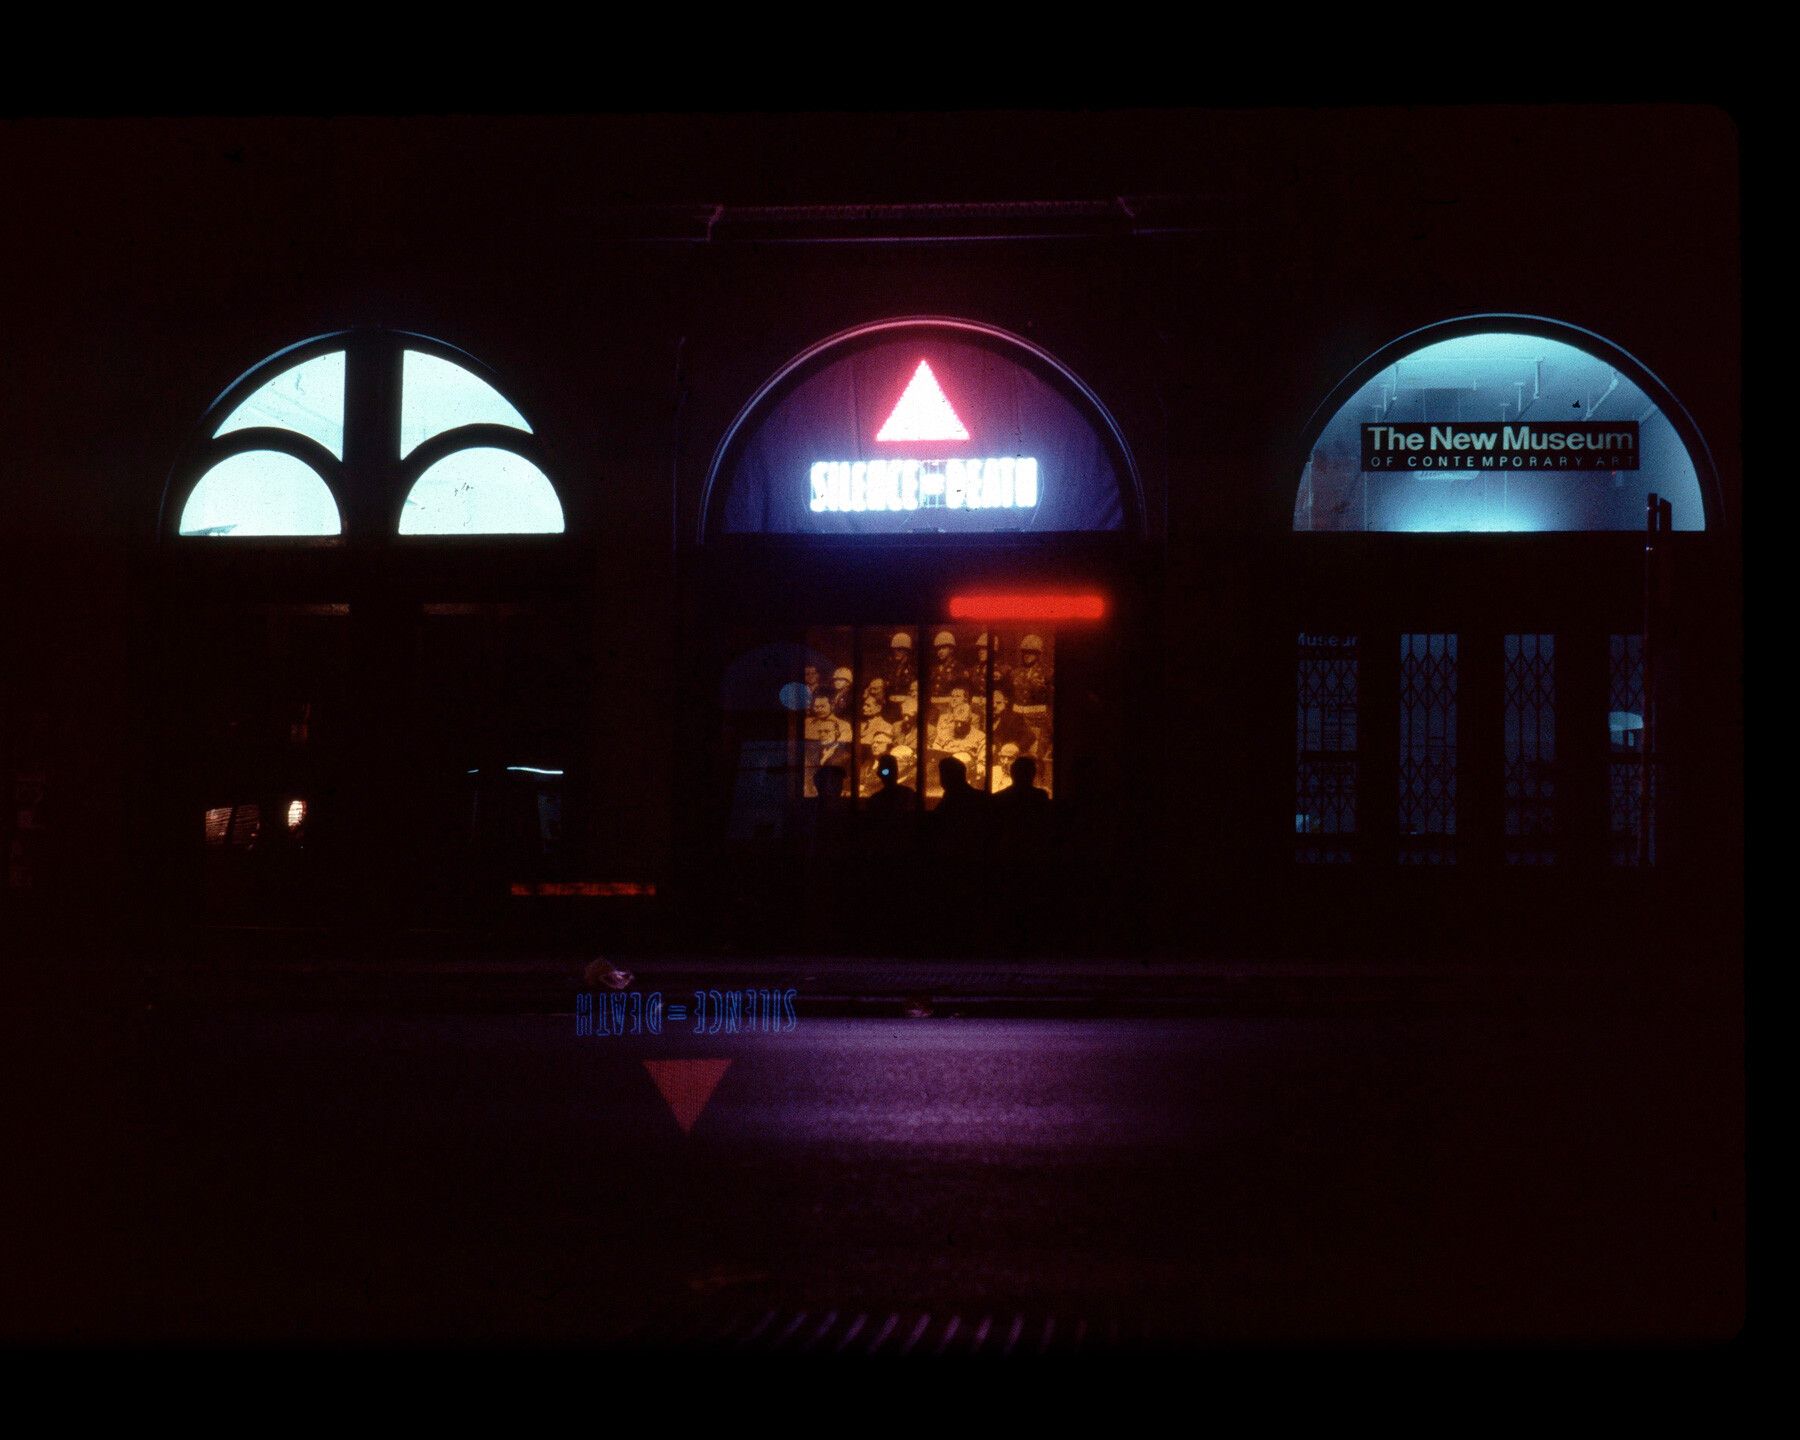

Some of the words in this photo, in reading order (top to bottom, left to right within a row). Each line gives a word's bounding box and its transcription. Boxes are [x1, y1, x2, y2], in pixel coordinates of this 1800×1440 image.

[1367, 426, 1425, 450] The
[1429, 426, 1498, 450] New
[1502, 426, 1634, 451] Museum
[1370, 456, 1394, 467] OF
[1407, 455, 1584, 468] CONTEMPORARY
[1596, 455, 1634, 467] ART
[810, 460, 919, 512] SILENCE
[945, 457, 1038, 509] DEATH
[576, 991, 663, 1036] DEATH
[693, 988, 798, 1034] SILENCE
